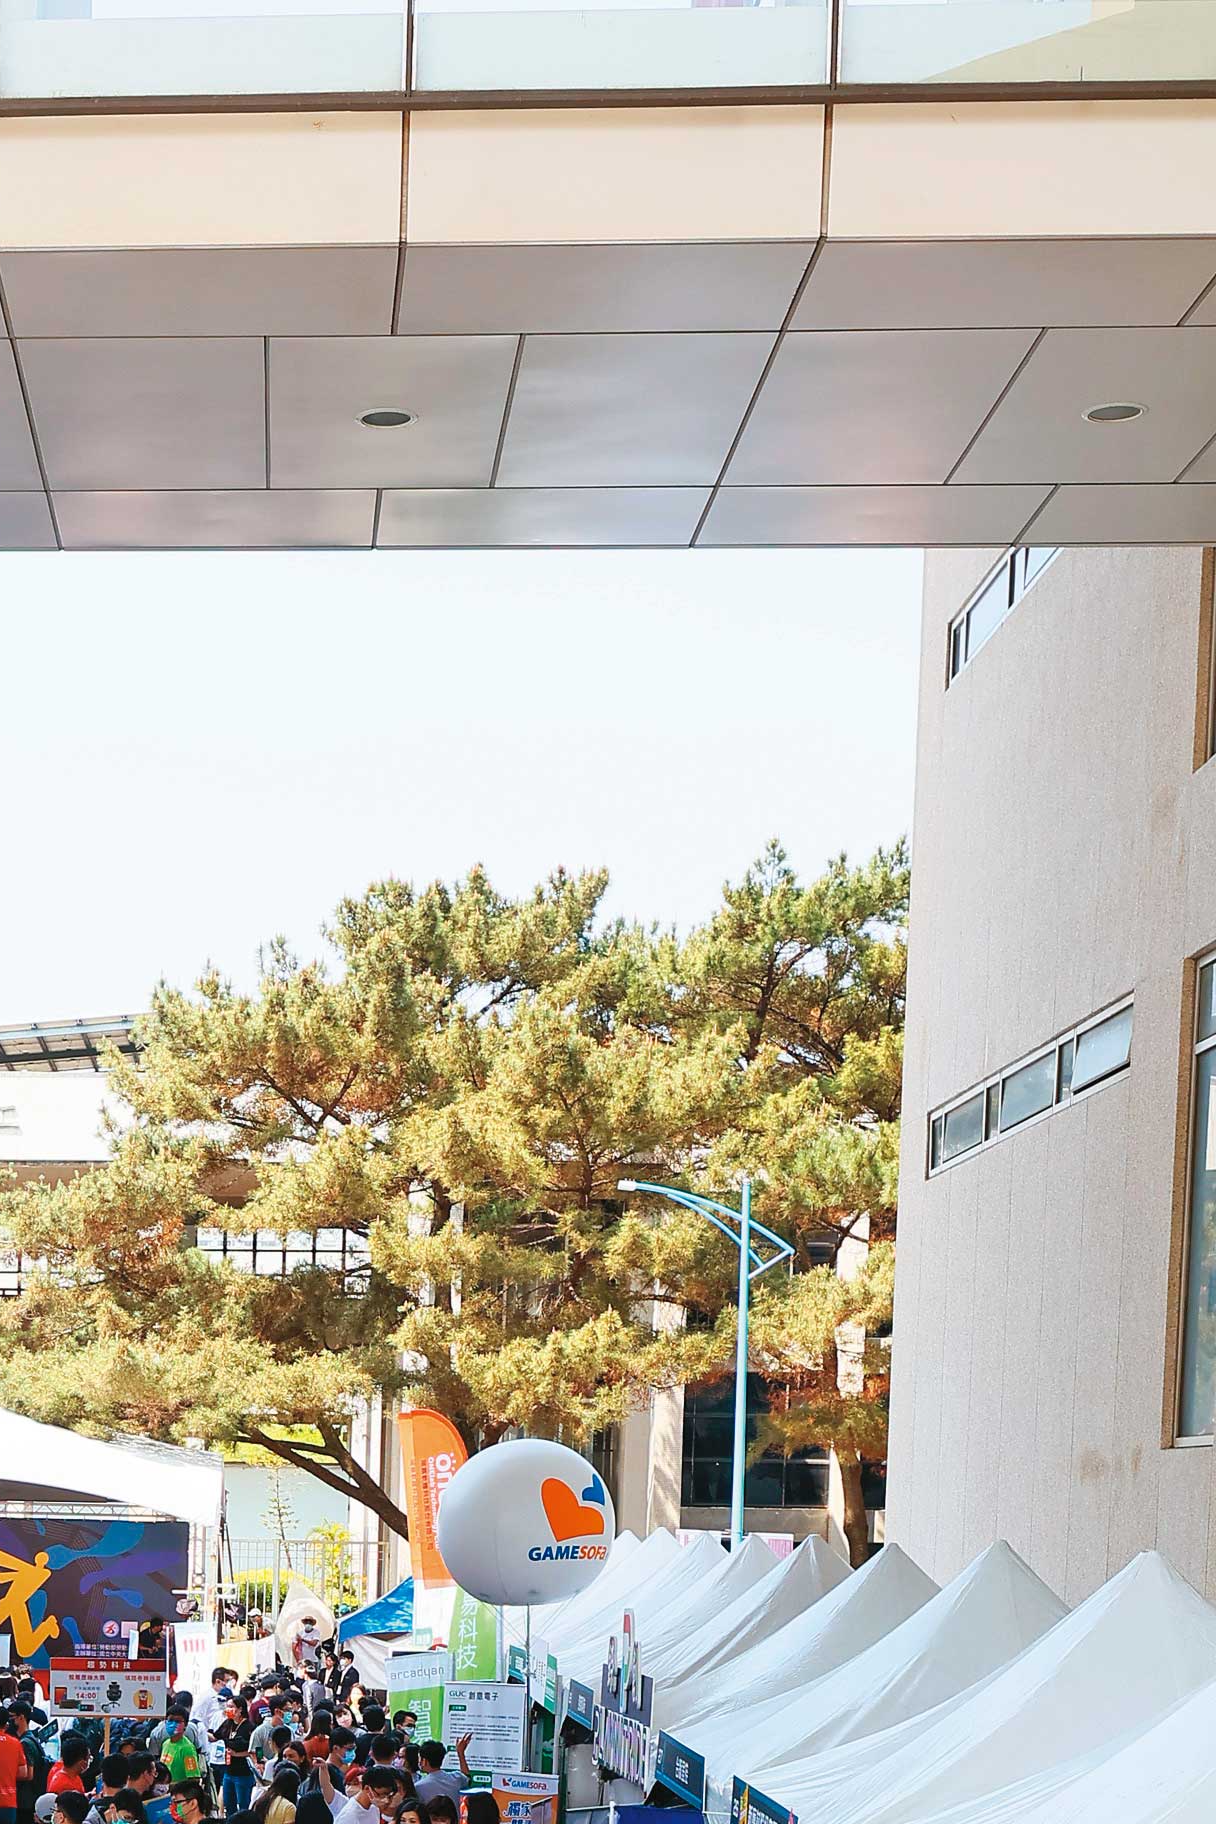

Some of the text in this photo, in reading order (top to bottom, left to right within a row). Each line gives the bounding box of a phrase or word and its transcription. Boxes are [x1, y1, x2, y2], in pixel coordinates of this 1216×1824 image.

[390, 1665, 445, 1680] arcadyan
[449, 1690, 466, 1698] GUC
[469, 1690, 499, 1701] 創意電子
